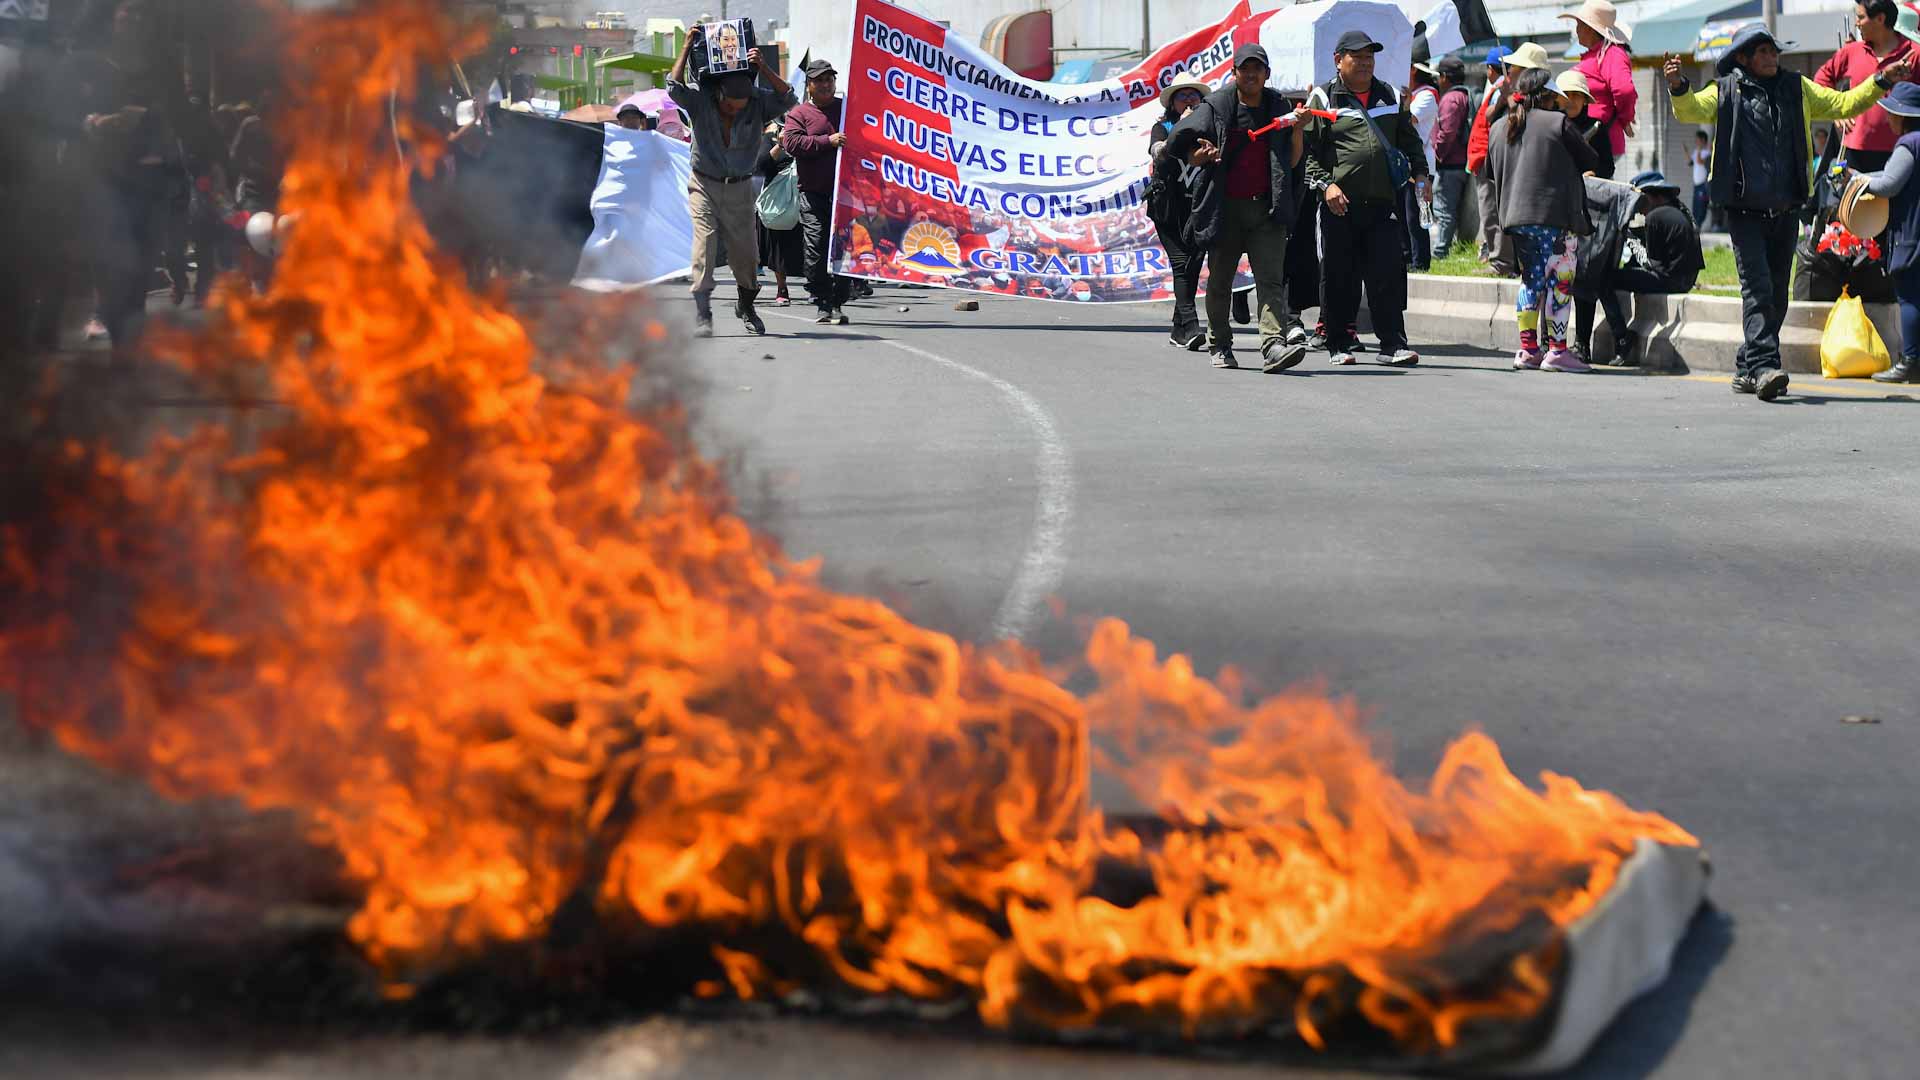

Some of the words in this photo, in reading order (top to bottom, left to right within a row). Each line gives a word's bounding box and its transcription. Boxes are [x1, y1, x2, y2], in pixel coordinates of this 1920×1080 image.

[1129, 81, 1152, 99] A.
[1159, 27, 1236, 89] CACERE
[887, 69, 987, 126] CIERRE
[998, 107, 1057, 137] DEL
[885, 112, 1007, 172] NUEVAS
[883, 157, 991, 211] NUEVA
[971, 248, 1172, 275] GRATER
